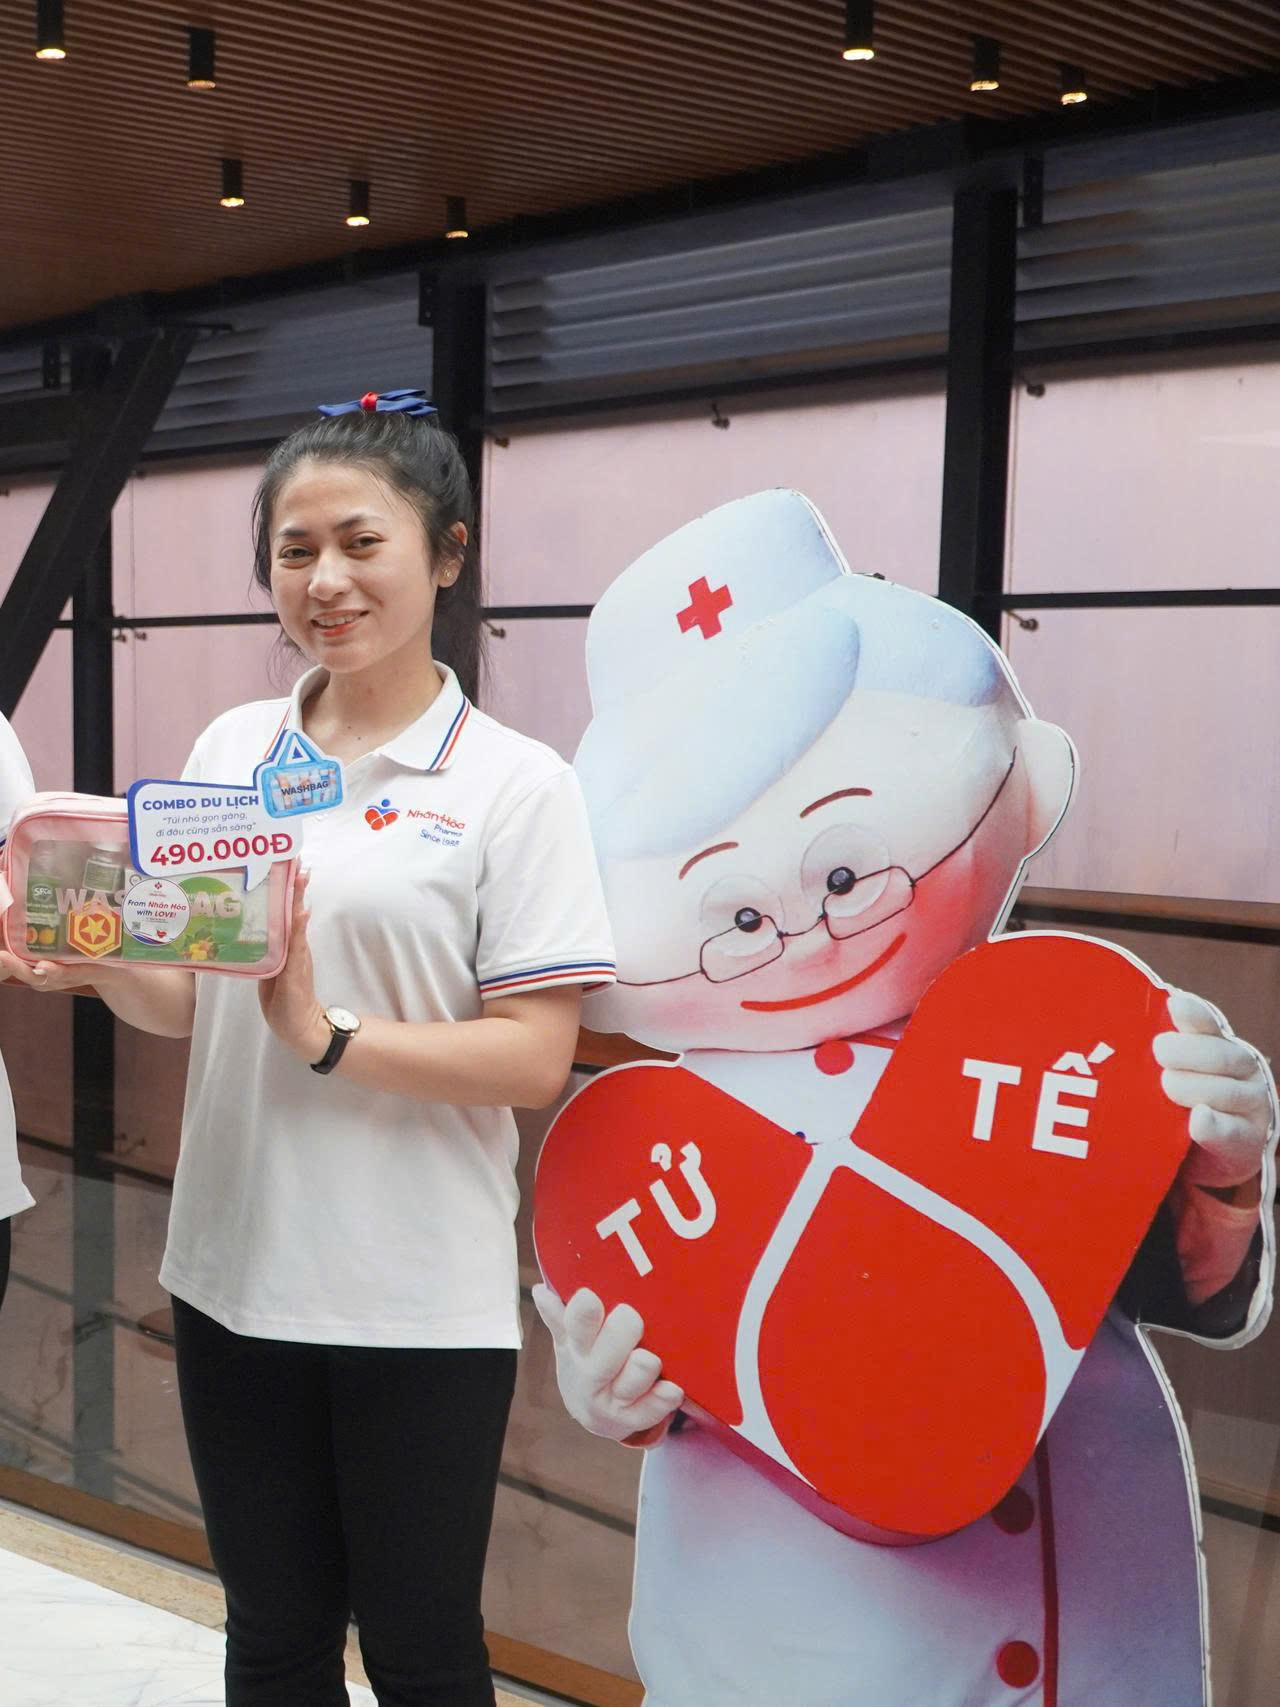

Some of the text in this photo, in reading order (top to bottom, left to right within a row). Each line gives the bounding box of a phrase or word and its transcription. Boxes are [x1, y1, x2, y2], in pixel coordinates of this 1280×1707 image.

[281, 781, 329, 796] WASHBAG
[142, 795, 259, 811] COMBO DU LỊCH
[155, 829, 165, 837] đi
[187, 826, 209, 835] cũng
[420, 829, 441, 843] Since
[150, 833, 293, 866] 490.000Đ
[961, 1041, 1116, 1160] TẾ
[595, 1141, 718, 1278] TỬ
